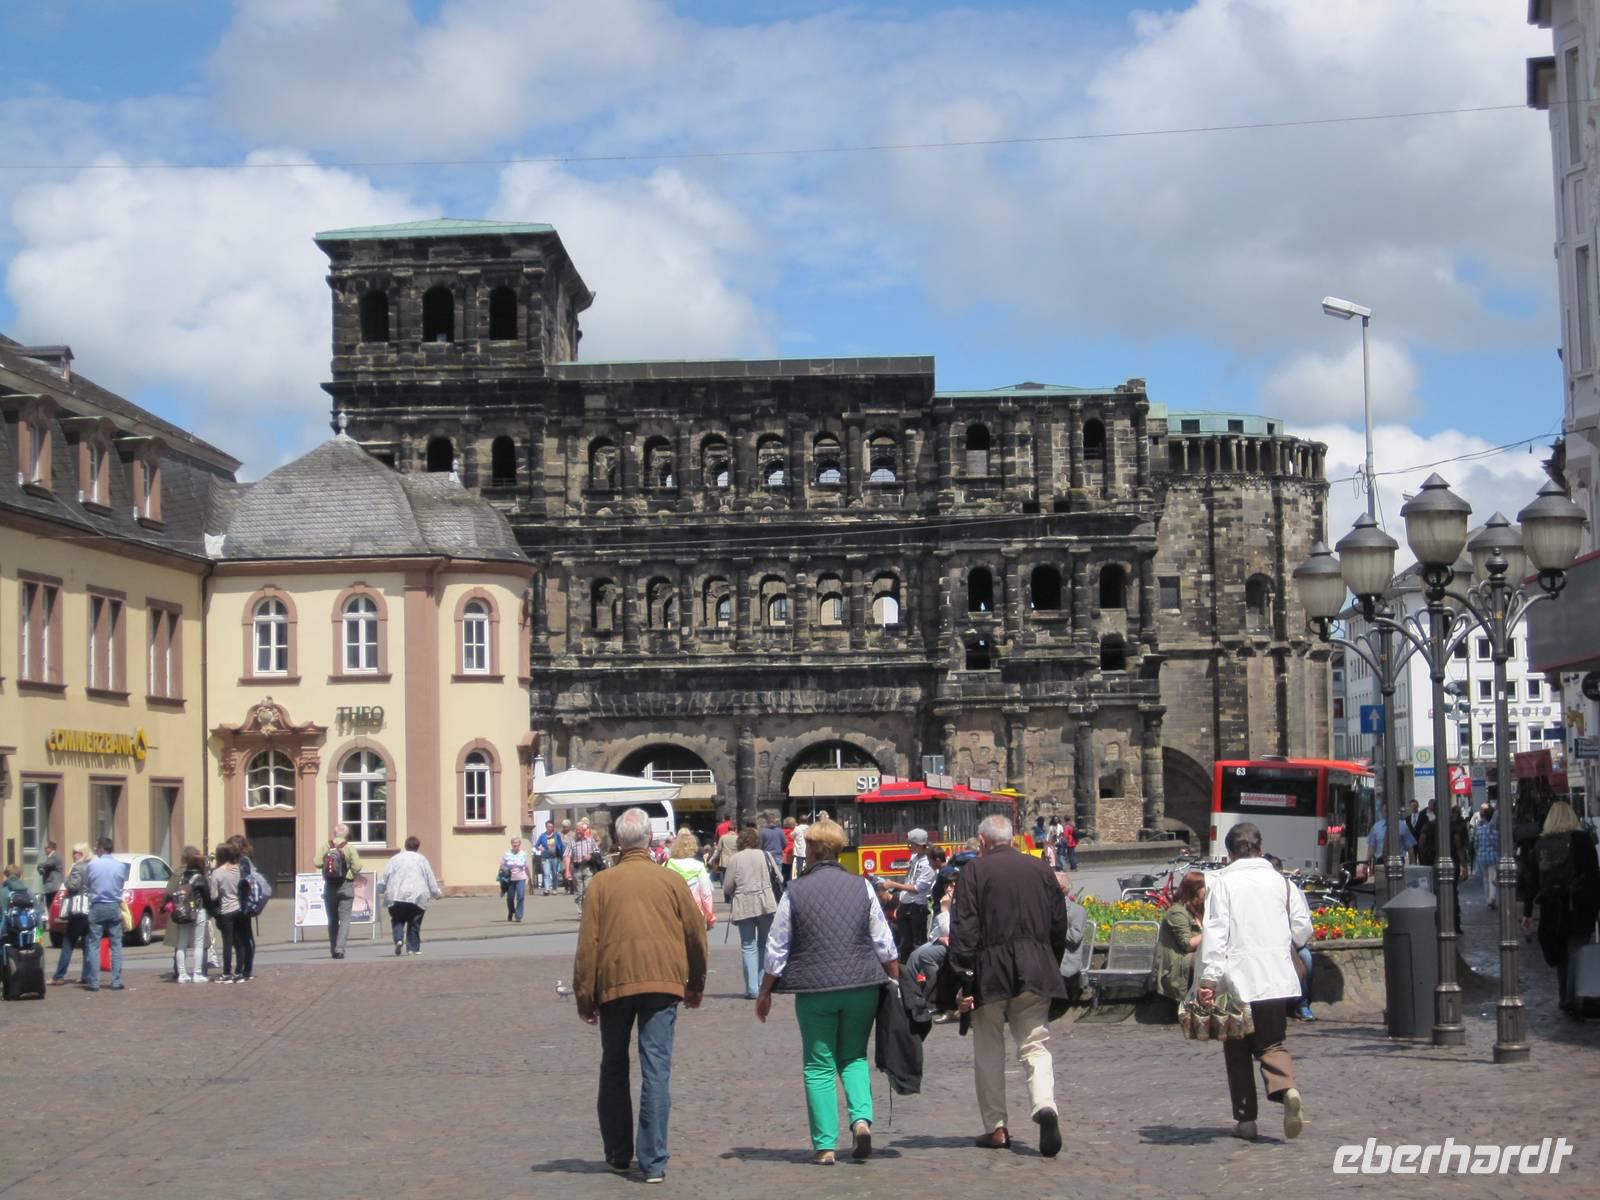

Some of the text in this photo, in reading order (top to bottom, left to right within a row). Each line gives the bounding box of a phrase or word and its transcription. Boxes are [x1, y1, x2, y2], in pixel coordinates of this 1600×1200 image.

[336, 705, 384, 721] THEO
[47, 728, 133, 755] COMMERZBANK
[1235, 767, 1246, 776] 63
[857, 776, 879, 790] SP
